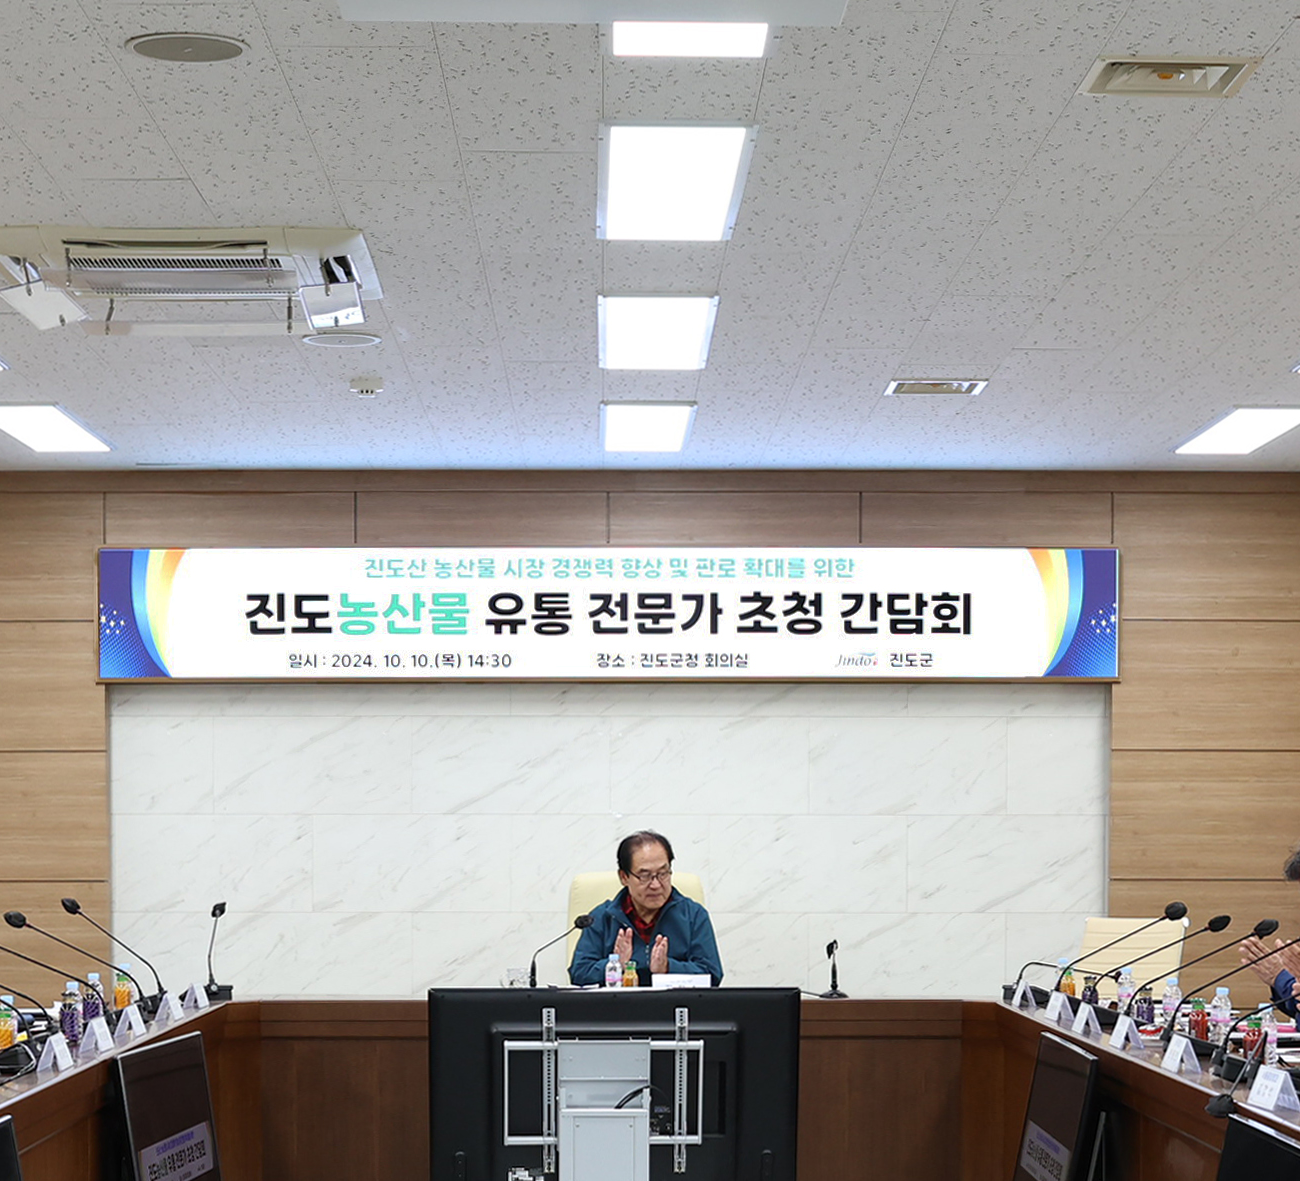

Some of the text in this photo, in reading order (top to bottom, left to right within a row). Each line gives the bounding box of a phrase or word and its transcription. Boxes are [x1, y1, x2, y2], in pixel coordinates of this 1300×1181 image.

[365, 557, 856, 579] 진도산 농산물 시장 경쟁력 향상 및 판로 확대를 위한
[245, 591, 972, 636] 진도농산물 유통 전문가 초청 간담회
[288, 653, 318, 669] 일시
[331, 653, 378, 669] 2024.
[467, 653, 512, 669] 14:30
[596, 653, 626, 669] 장소
[640, 653, 699, 669] 진도군청
[704, 653, 749, 669] 회의실
[889, 653, 934, 668] 진도군
